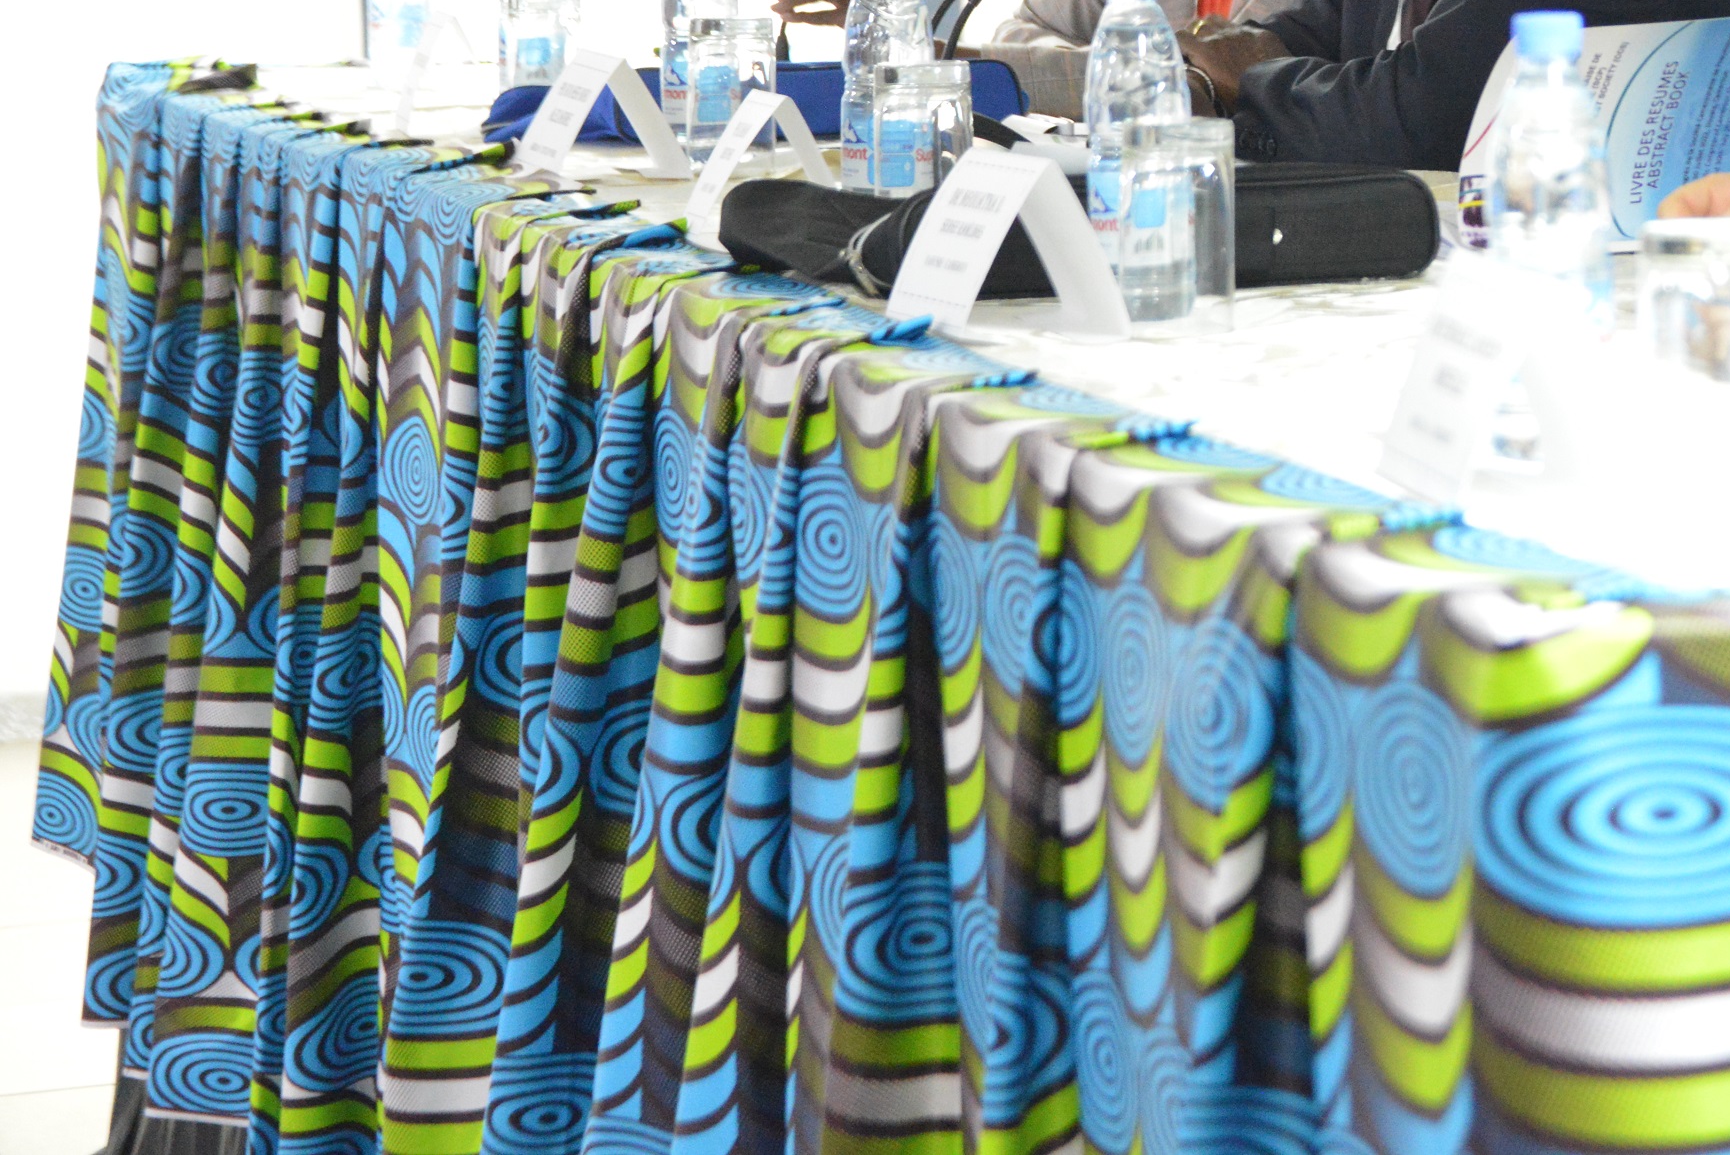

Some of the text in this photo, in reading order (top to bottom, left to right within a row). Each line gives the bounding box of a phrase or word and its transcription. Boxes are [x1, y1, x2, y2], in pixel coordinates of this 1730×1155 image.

[1630, 60, 1680, 205] LIVRE DES RESUMES
[1647, 70, 1690, 189] ABSTRACT BOOK
